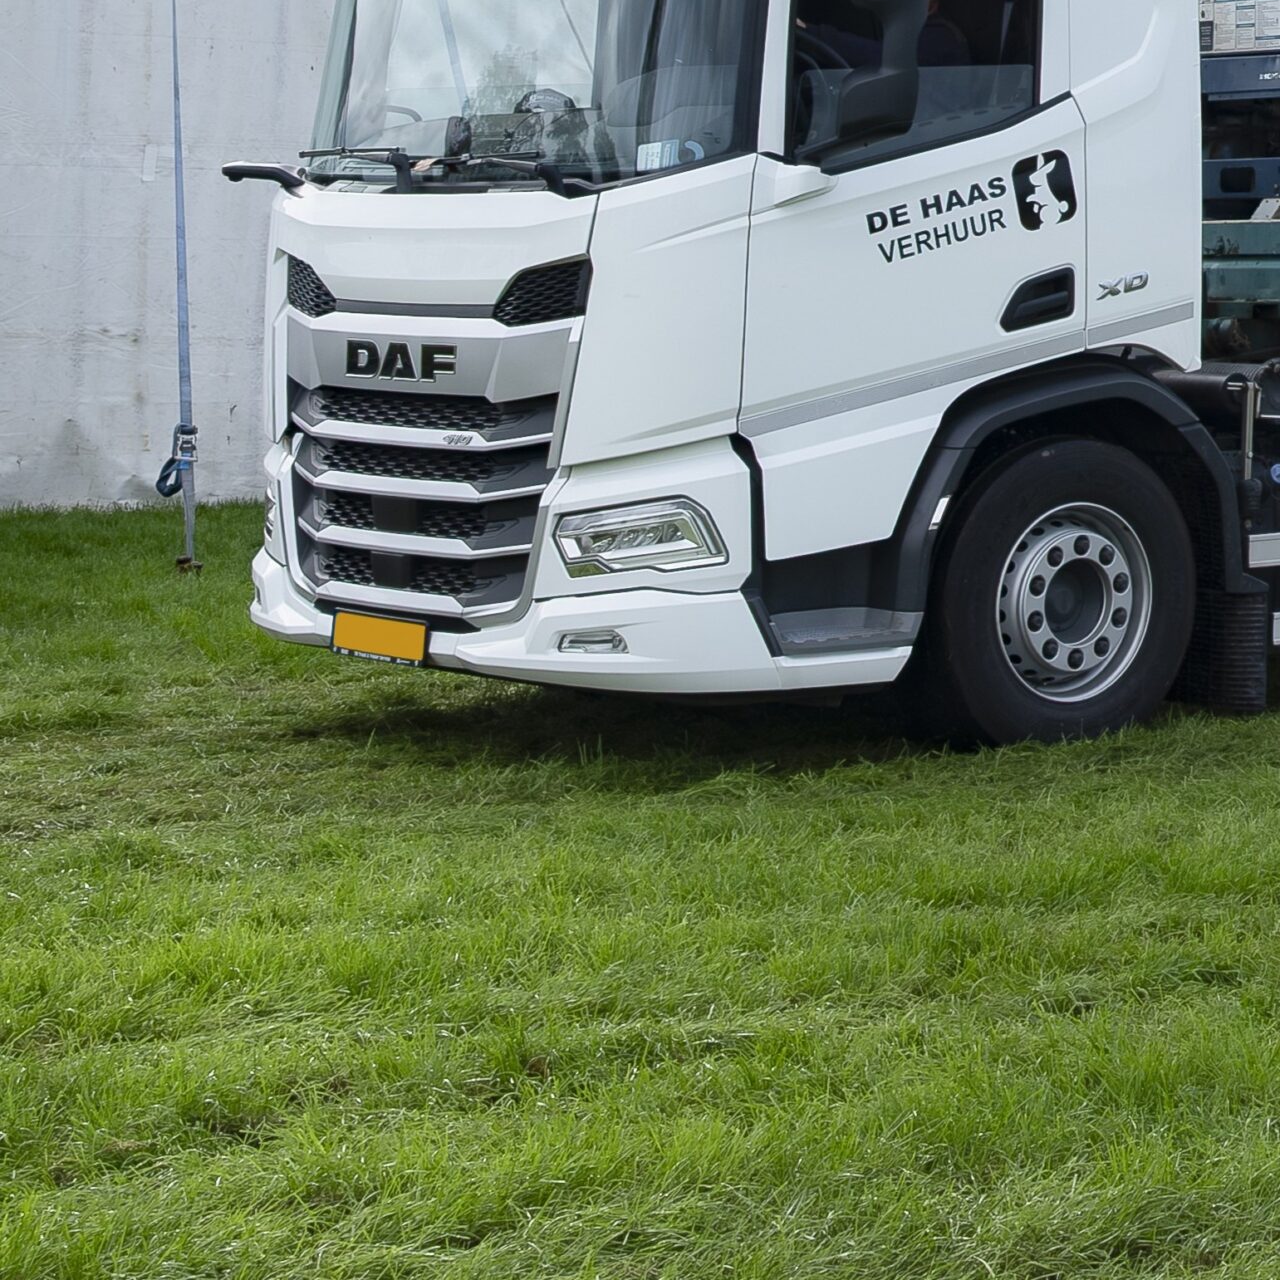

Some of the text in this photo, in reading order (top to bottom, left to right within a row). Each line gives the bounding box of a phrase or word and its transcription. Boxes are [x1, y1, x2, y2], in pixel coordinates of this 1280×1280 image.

[865, 176, 1007, 234] DE HAAS
[877, 208, 1007, 264] VERHUUR
[1096, 271, 1149, 300] XD
[345, 337, 457, 382] DAF
